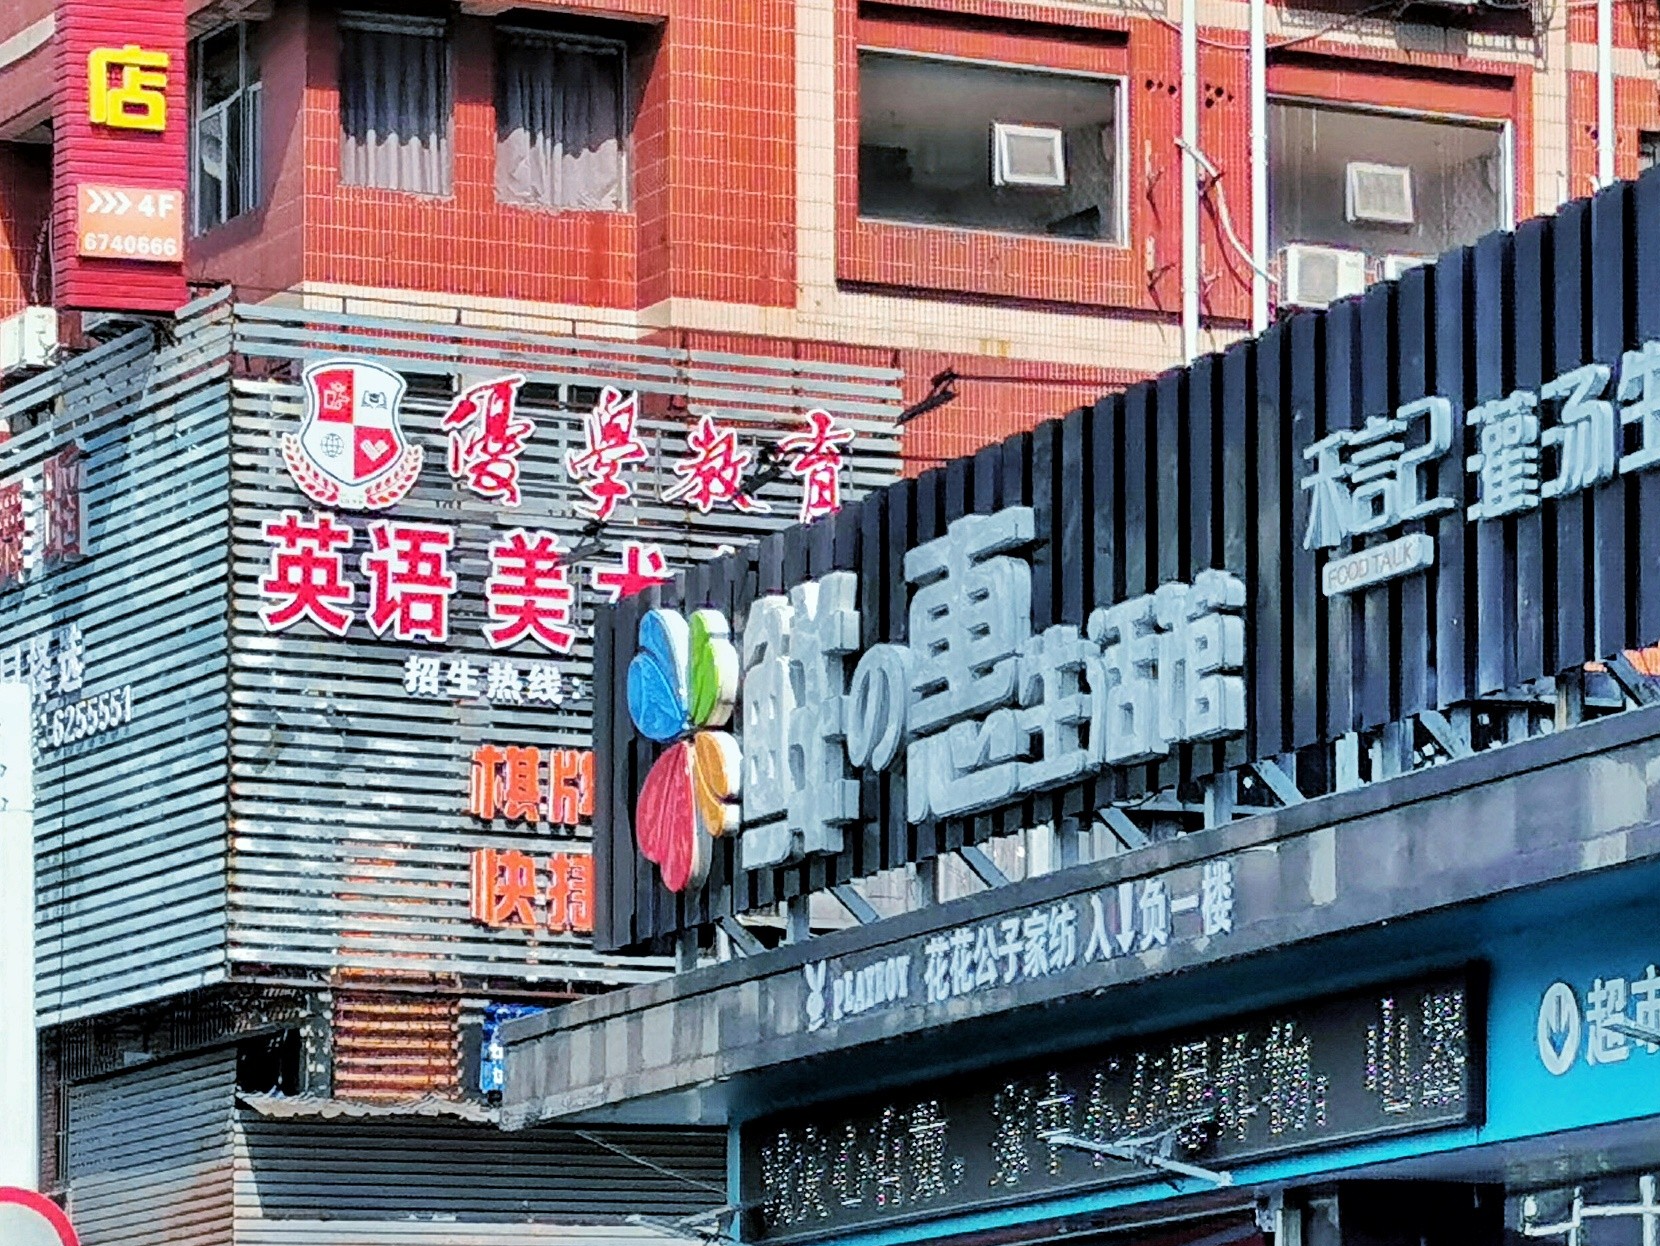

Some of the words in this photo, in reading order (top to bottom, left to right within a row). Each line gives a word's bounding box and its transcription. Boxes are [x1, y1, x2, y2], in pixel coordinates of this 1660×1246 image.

[88, 44, 170, 131] 店
[137, 193, 176, 219] 4F
[83, 232, 178, 257] 6740666
[1327, 554, 1368, 588] FOOD
[1372, 540, 1414, 576] TALK
